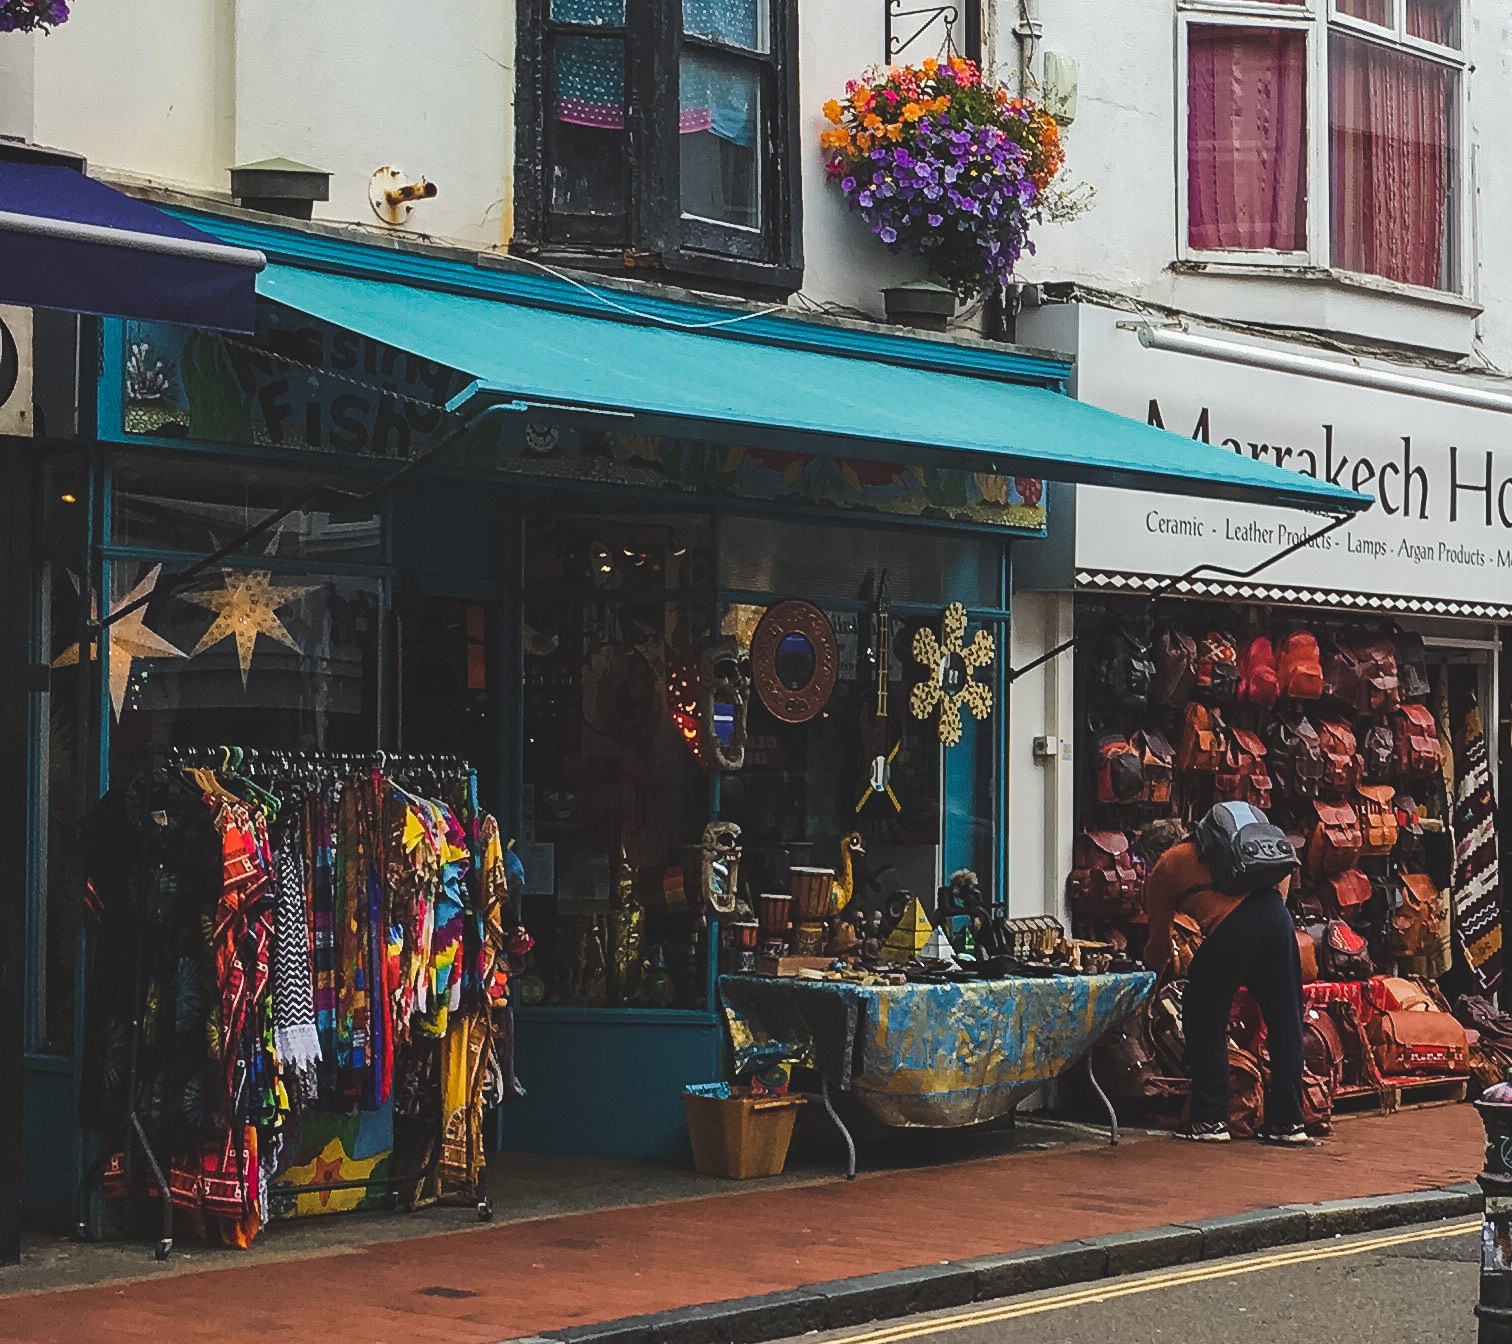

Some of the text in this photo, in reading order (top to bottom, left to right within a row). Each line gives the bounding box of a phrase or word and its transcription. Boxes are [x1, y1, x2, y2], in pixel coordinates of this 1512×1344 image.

[1146, 510, 1204, 537] Ceramic
[1225, 518, 1274, 544] Leather
[1347, 531, 1387, 559] Lamps
[1397, 538, 1434, 564] Argan
[1438, 541, 1485, 567] Products
